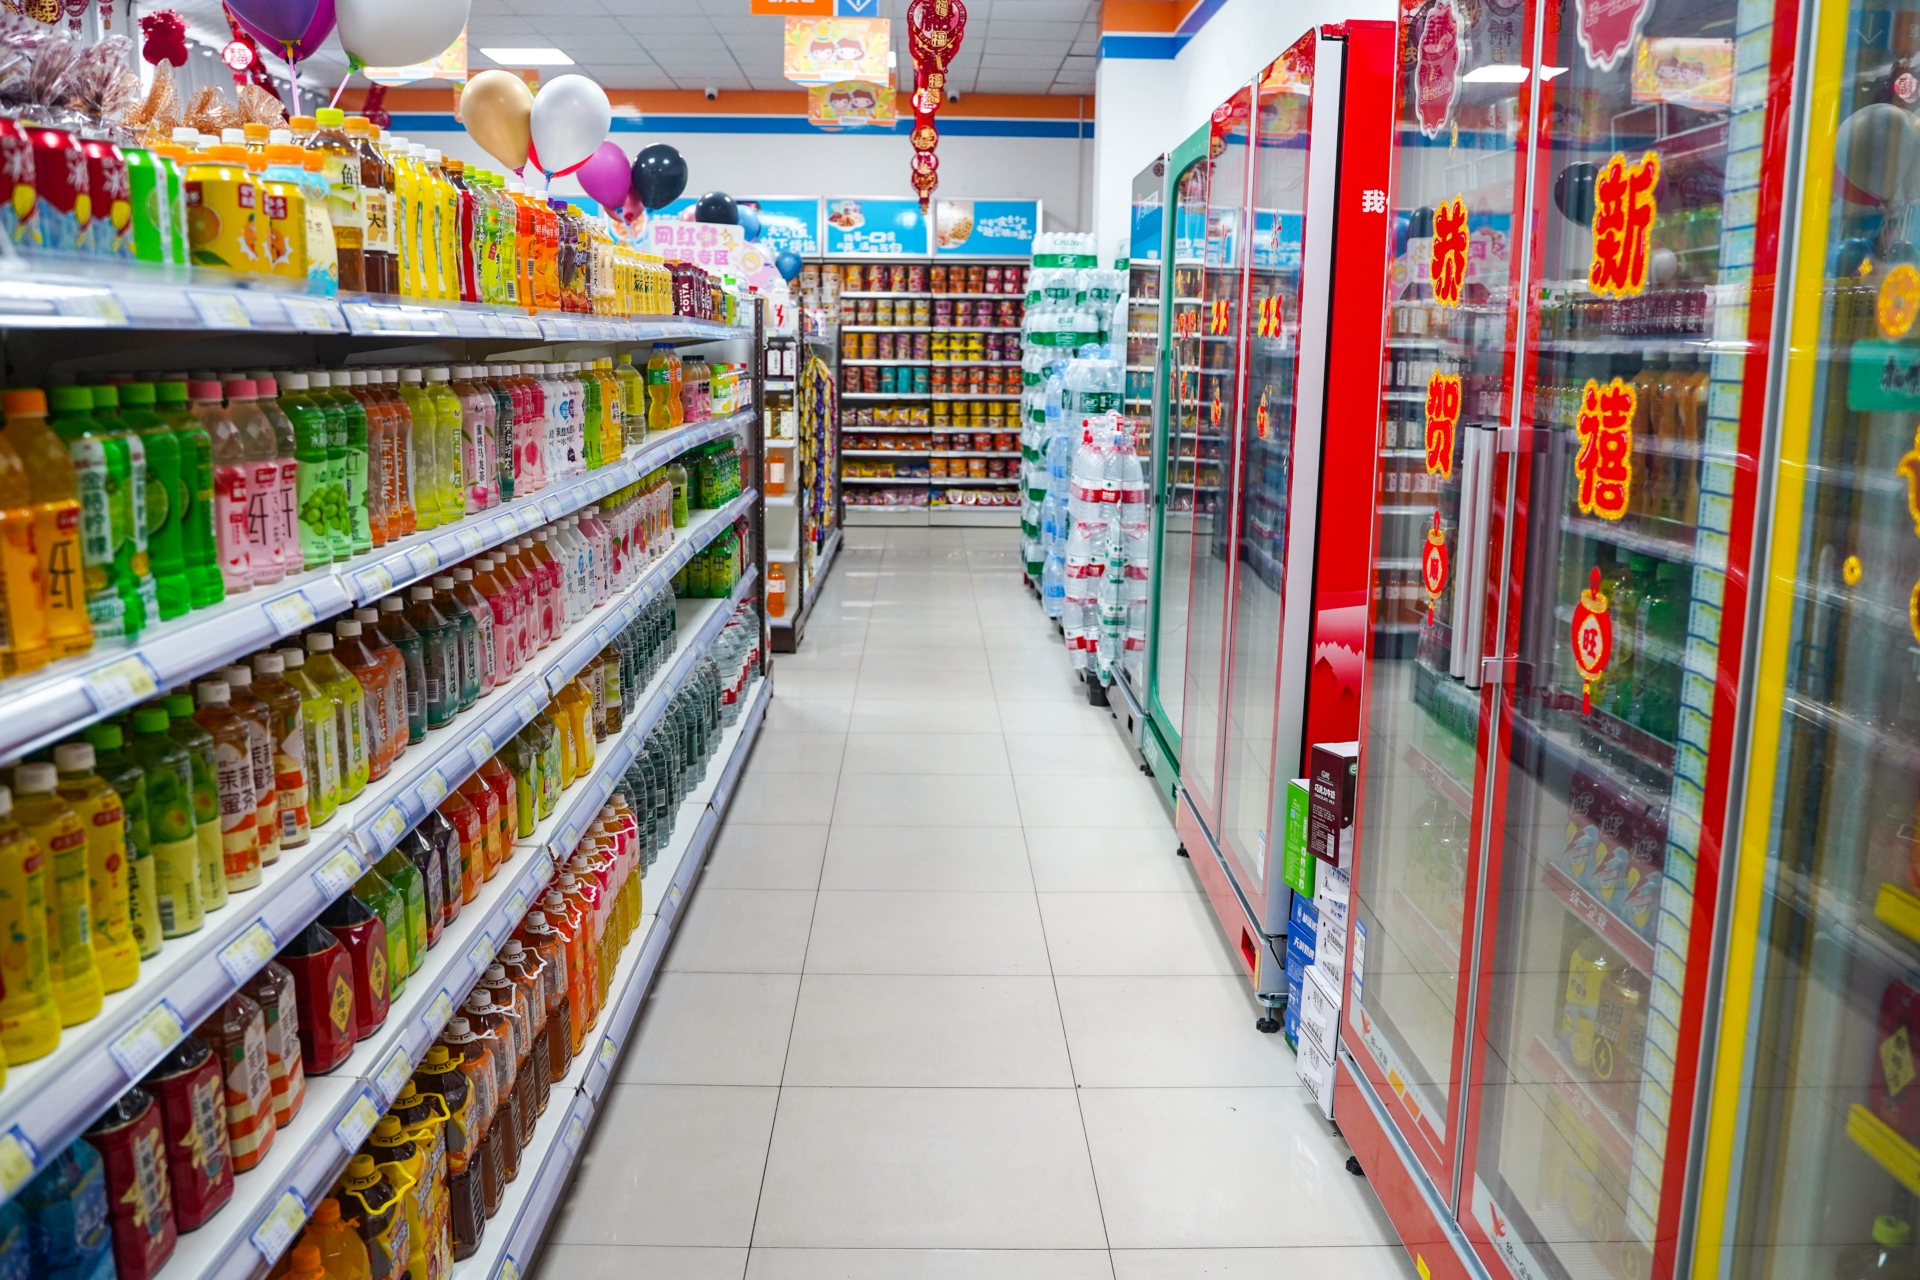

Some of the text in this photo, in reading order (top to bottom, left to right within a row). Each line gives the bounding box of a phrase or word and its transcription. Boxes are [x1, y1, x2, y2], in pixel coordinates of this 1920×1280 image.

[1362, 190, 1390, 214] 我
[1590, 152, 1660, 298] 新
[654, 225, 695, 247] 网红
[1430, 193, 1469, 307] 恭
[476, 424, 485, 482] 蜜桃乌龙茶
[1424, 369, 1461, 479] 贺
[1576, 377, 1637, 520] 禧
[1583, 628, 1598, 659] 旺
[1569, 888, 1608, 930] 统一企业
